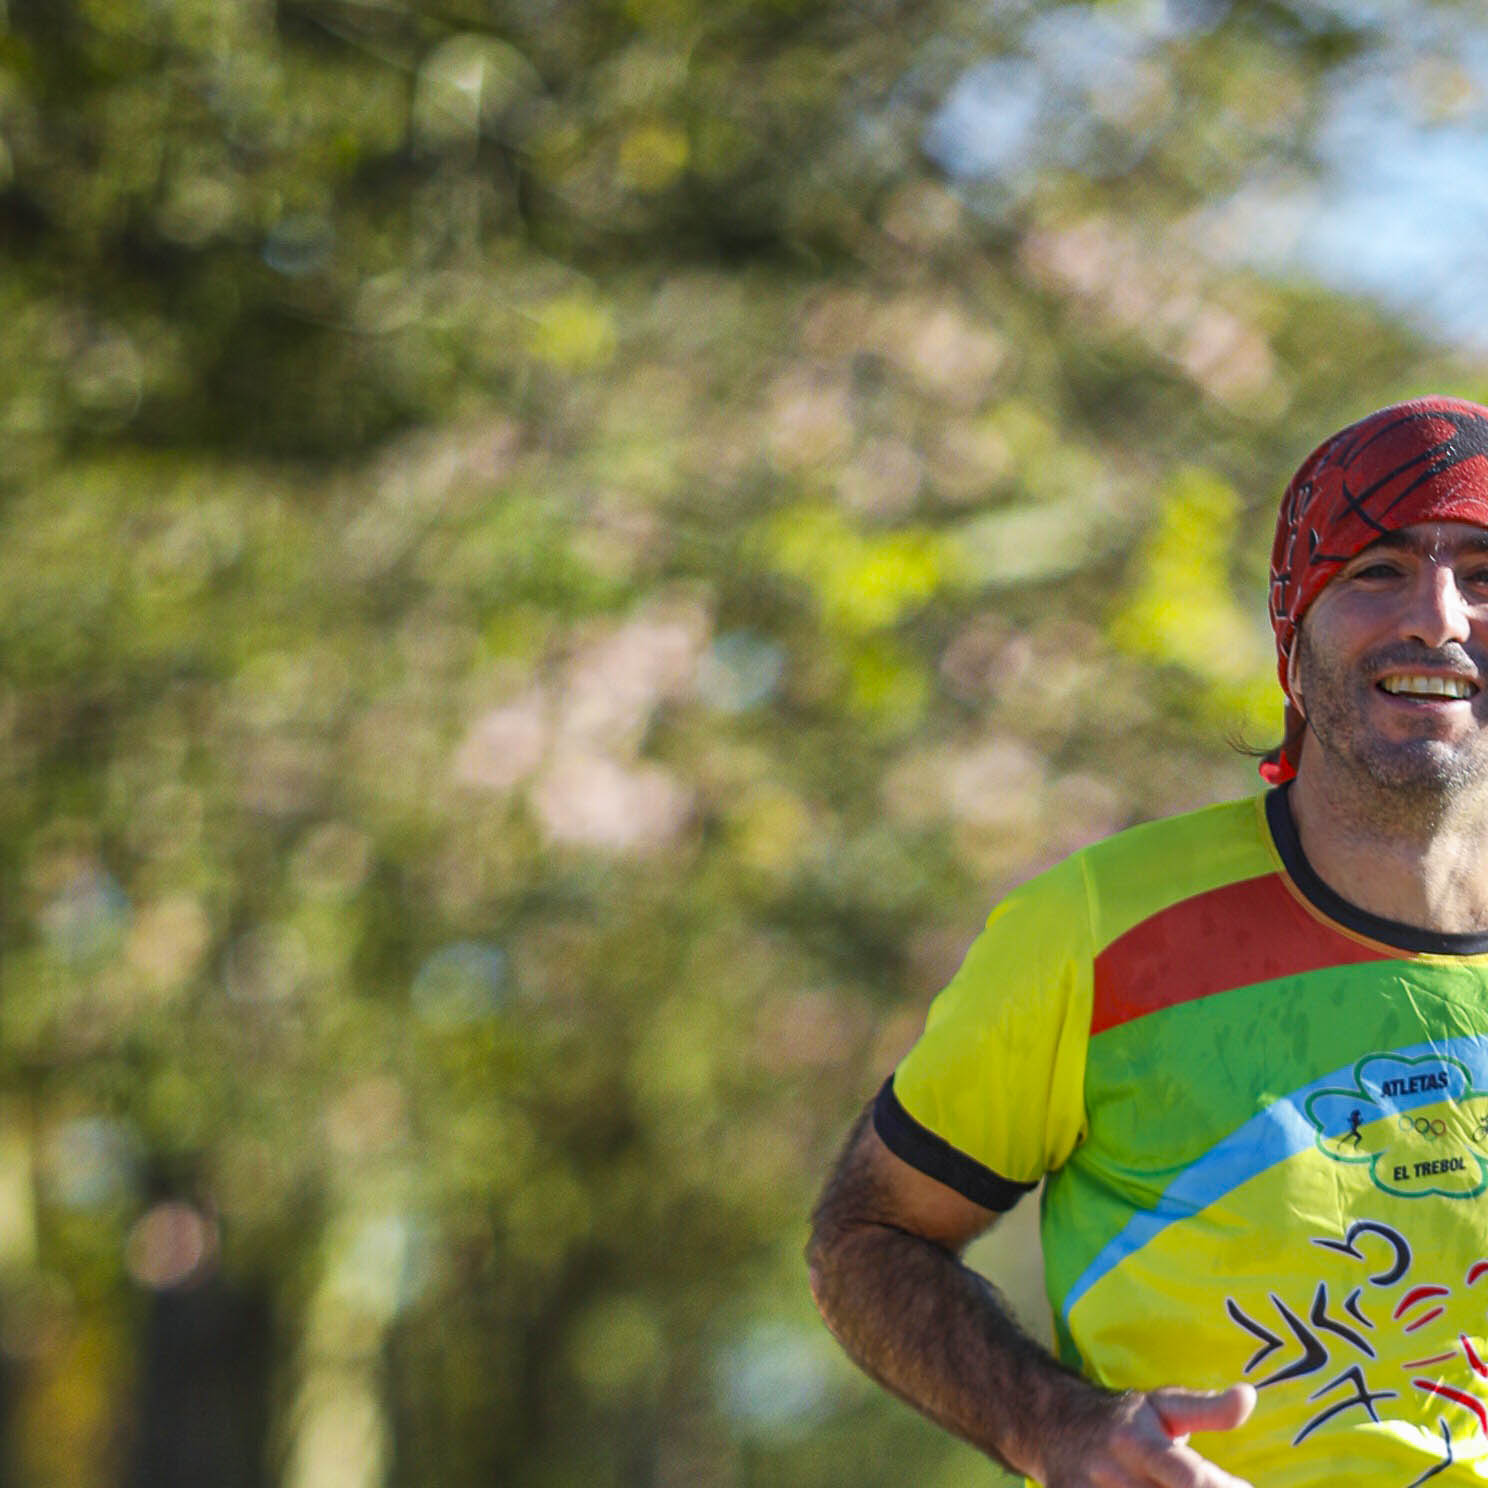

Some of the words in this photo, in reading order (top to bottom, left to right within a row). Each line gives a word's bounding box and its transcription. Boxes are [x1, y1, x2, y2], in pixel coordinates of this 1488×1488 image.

[1382, 1071, 1448, 1097] ATLETAS
[1393, 1165, 1410, 1181] EL
[1414, 1157, 1467, 1176] TREBOL
